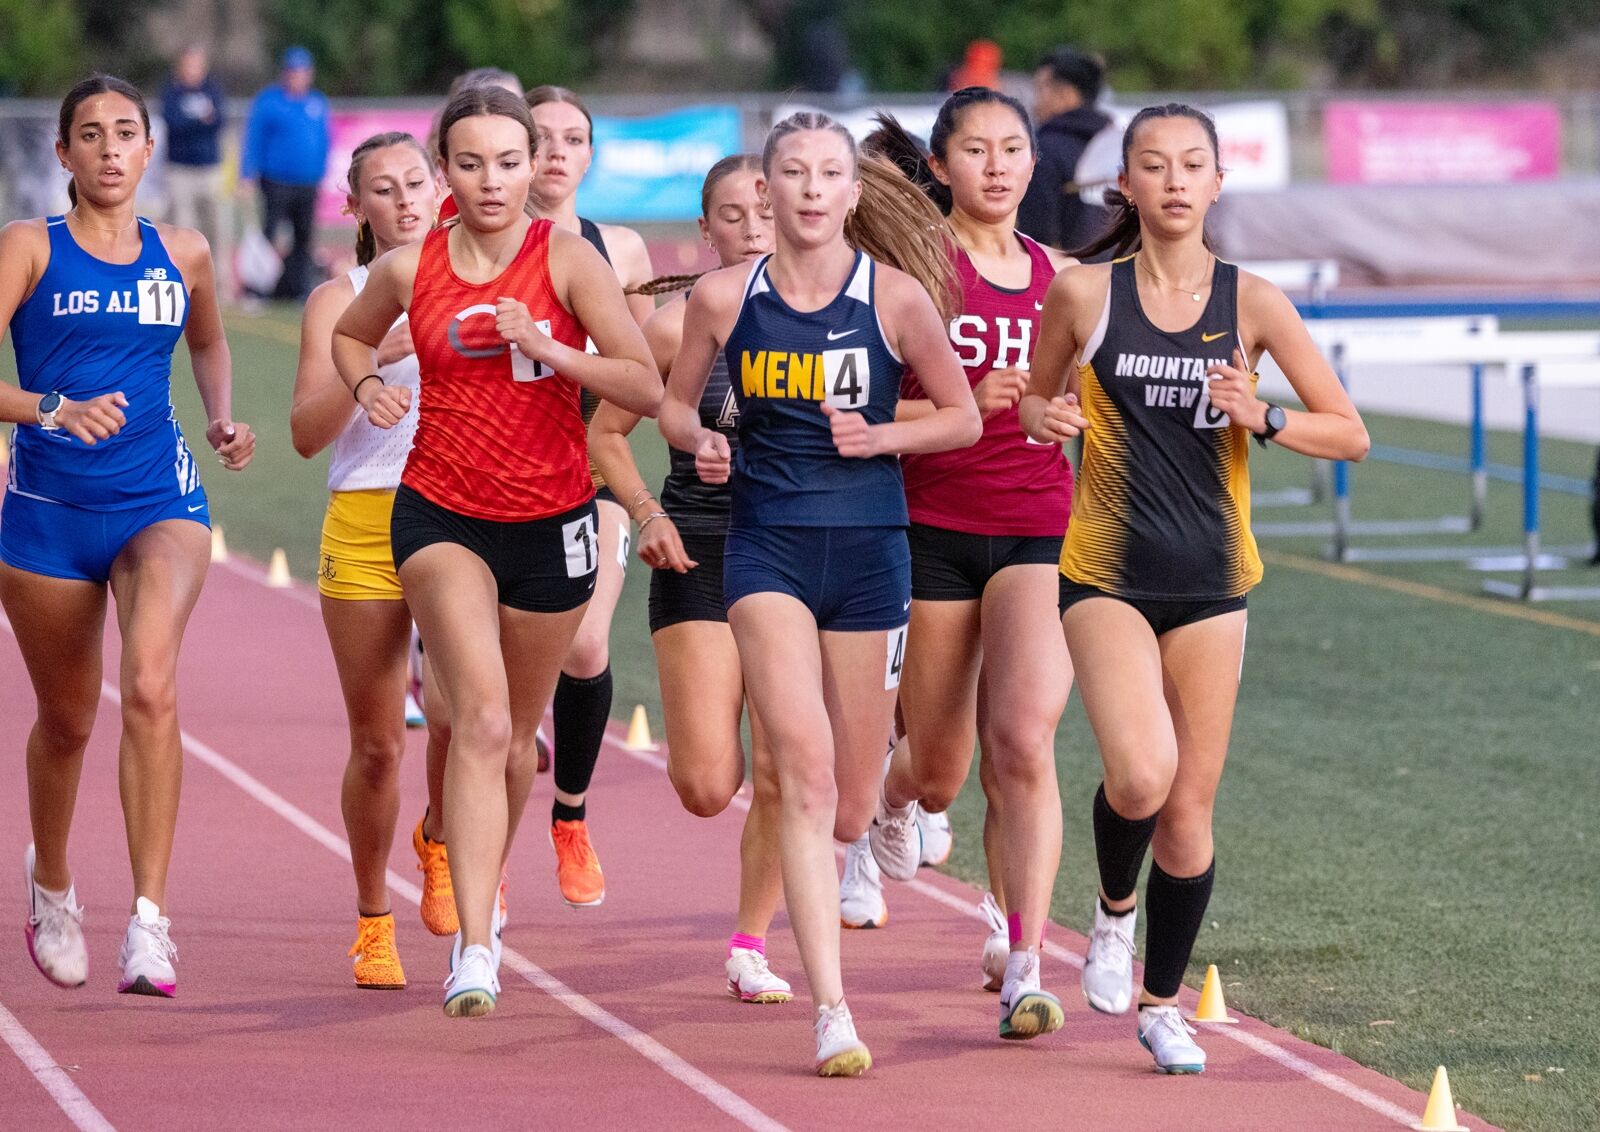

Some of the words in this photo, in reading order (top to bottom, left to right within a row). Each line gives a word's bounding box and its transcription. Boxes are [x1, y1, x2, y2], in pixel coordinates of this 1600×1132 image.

[52, 290, 100, 317] LOS
[147, 282, 177, 323] 11
[949, 314, 1033, 371] SH
[833, 352, 863, 405] 4
[1145, 384, 1199, 409] VIEW
[574, 521, 592, 571] 1
[890, 630, 904, 683] 4
